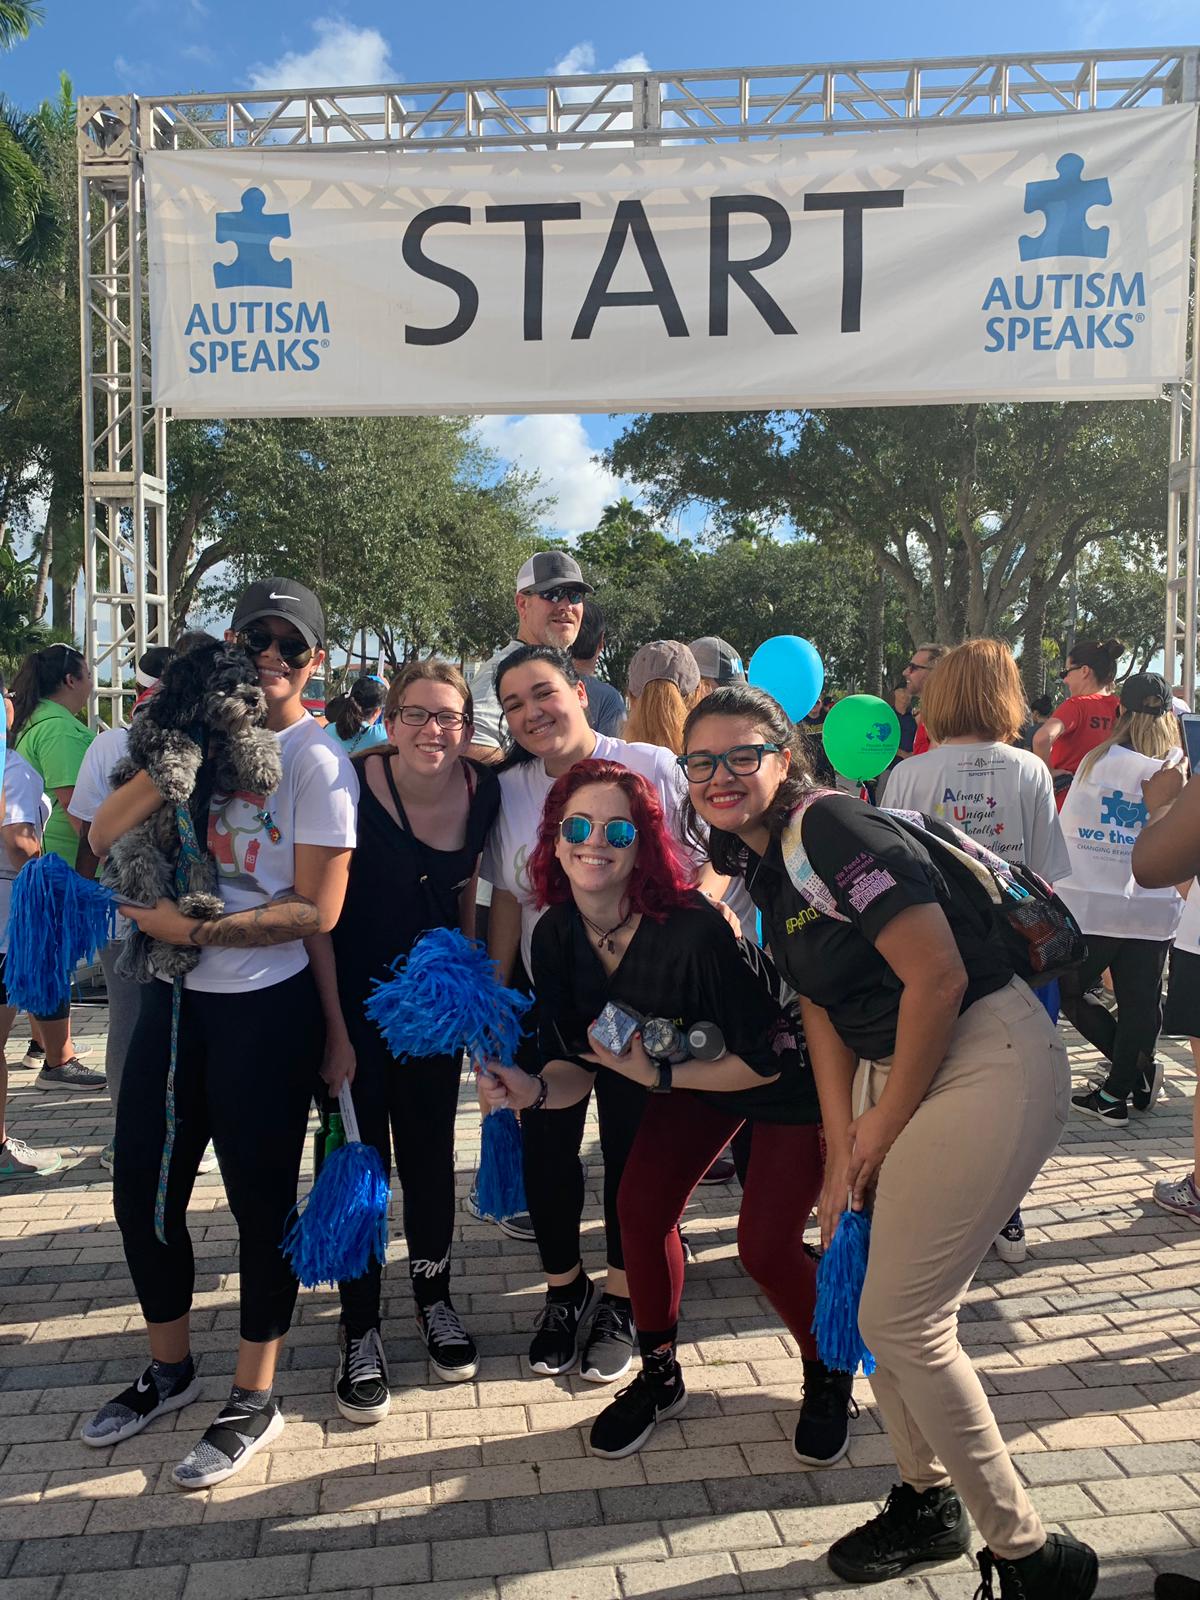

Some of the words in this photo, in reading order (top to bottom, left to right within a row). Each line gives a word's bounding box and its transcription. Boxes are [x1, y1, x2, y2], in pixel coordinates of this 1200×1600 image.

[402, 189, 904, 346] START
[981, 271, 1146, 310] AUTISM
[184, 300, 331, 336] AUTISM
[1090, 716, 1111, 729] ST
[943, 788, 984, 803] Always
[953, 806, 996, 822] Unique
[961, 820, 996, 837] Totally
[1078, 827, 1105, 841] we
[1109, 829, 1137, 845] the
[983, 841, 1024, 853] elligent
[1077, 843, 1110, 854] CHANGING
